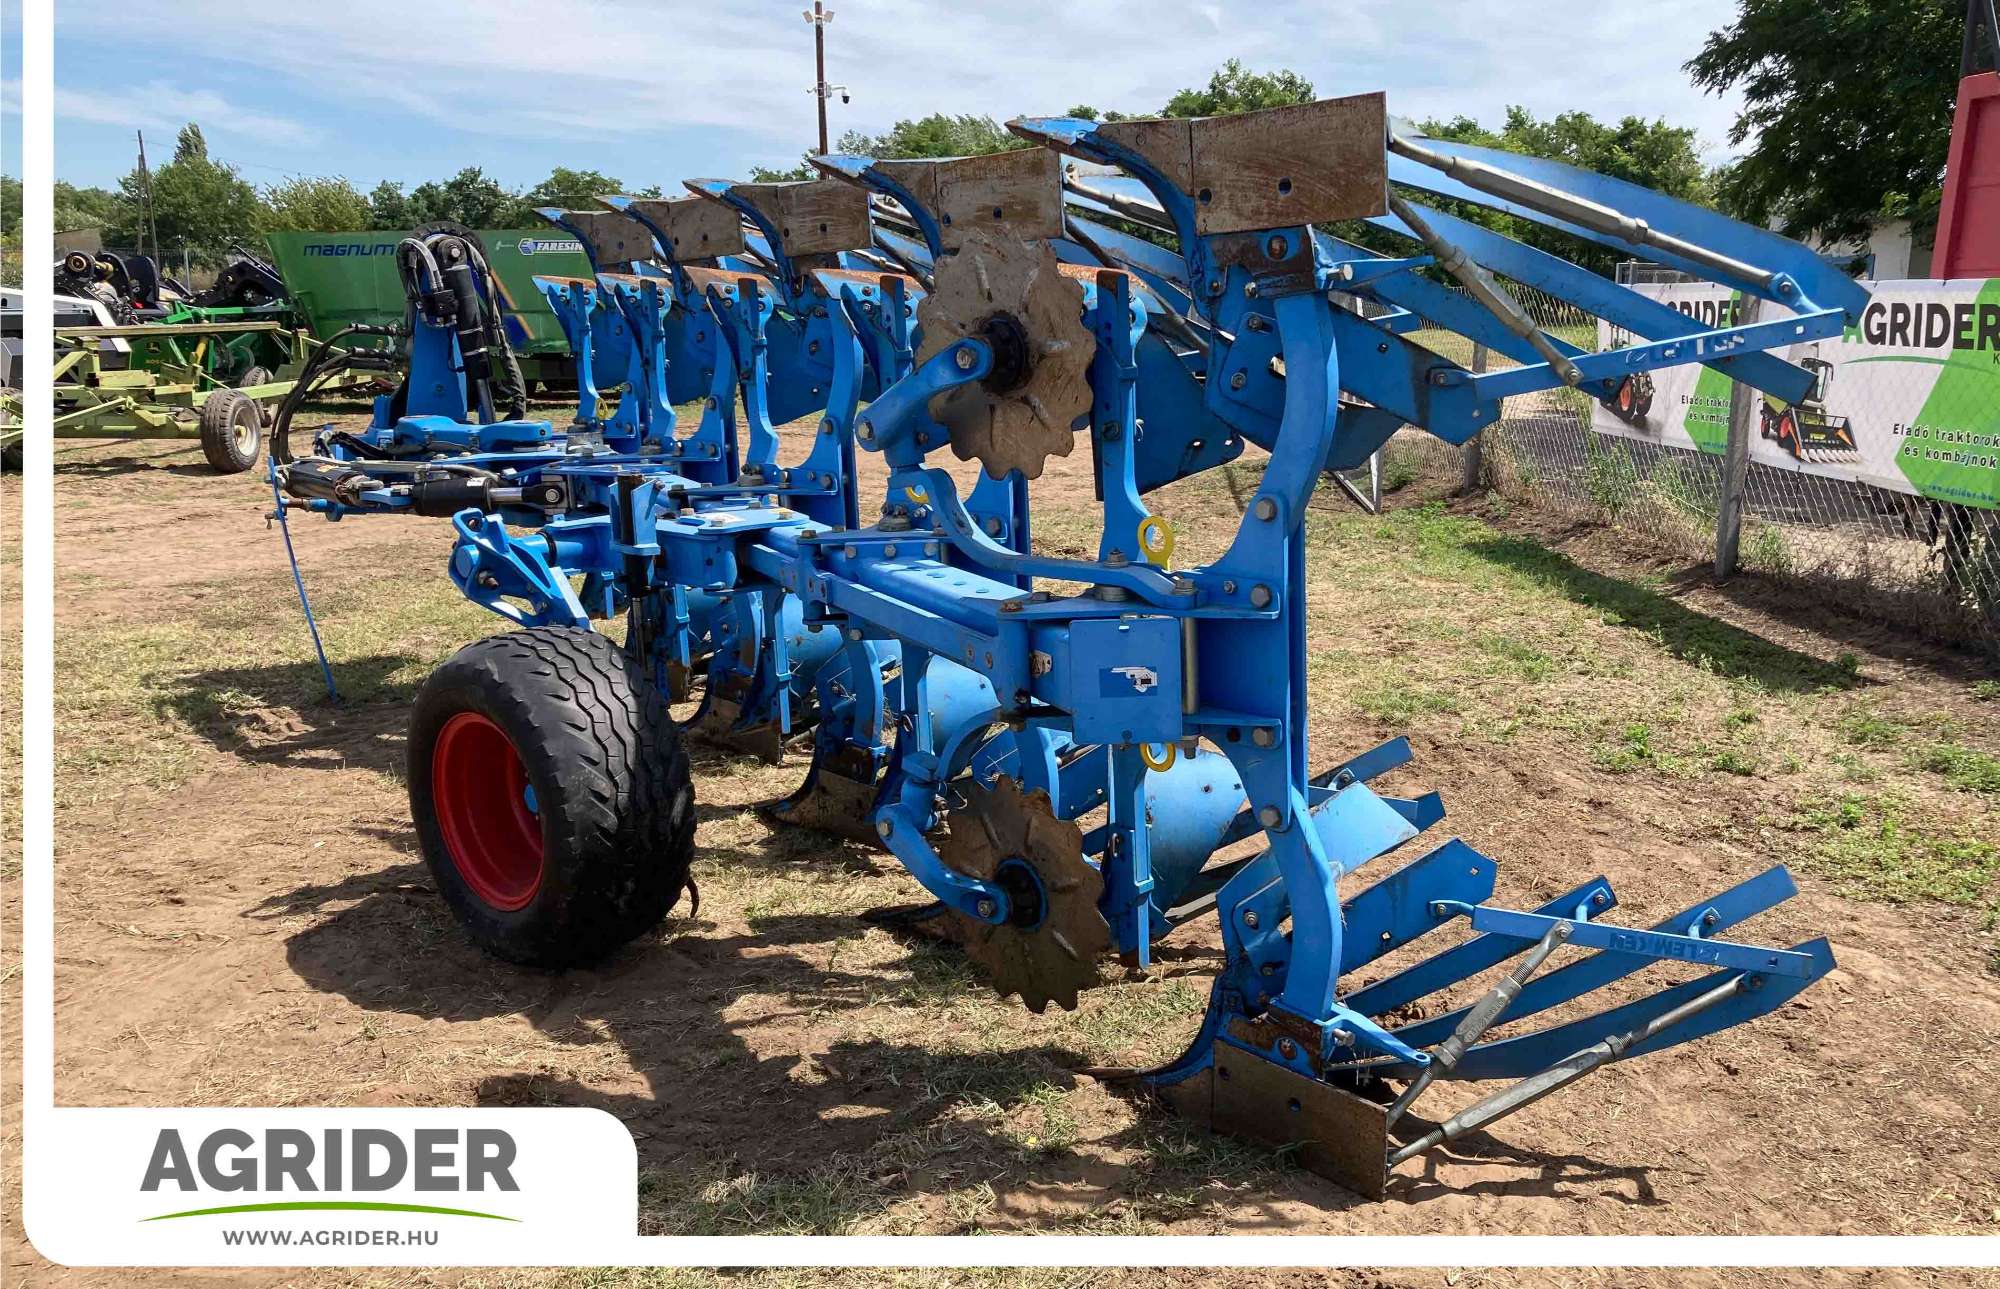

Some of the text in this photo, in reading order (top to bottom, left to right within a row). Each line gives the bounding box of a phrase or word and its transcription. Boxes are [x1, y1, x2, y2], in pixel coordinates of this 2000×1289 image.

[1893, 423, 2000, 447] Eladó traktorok
[1904, 441, 1919, 456] és
